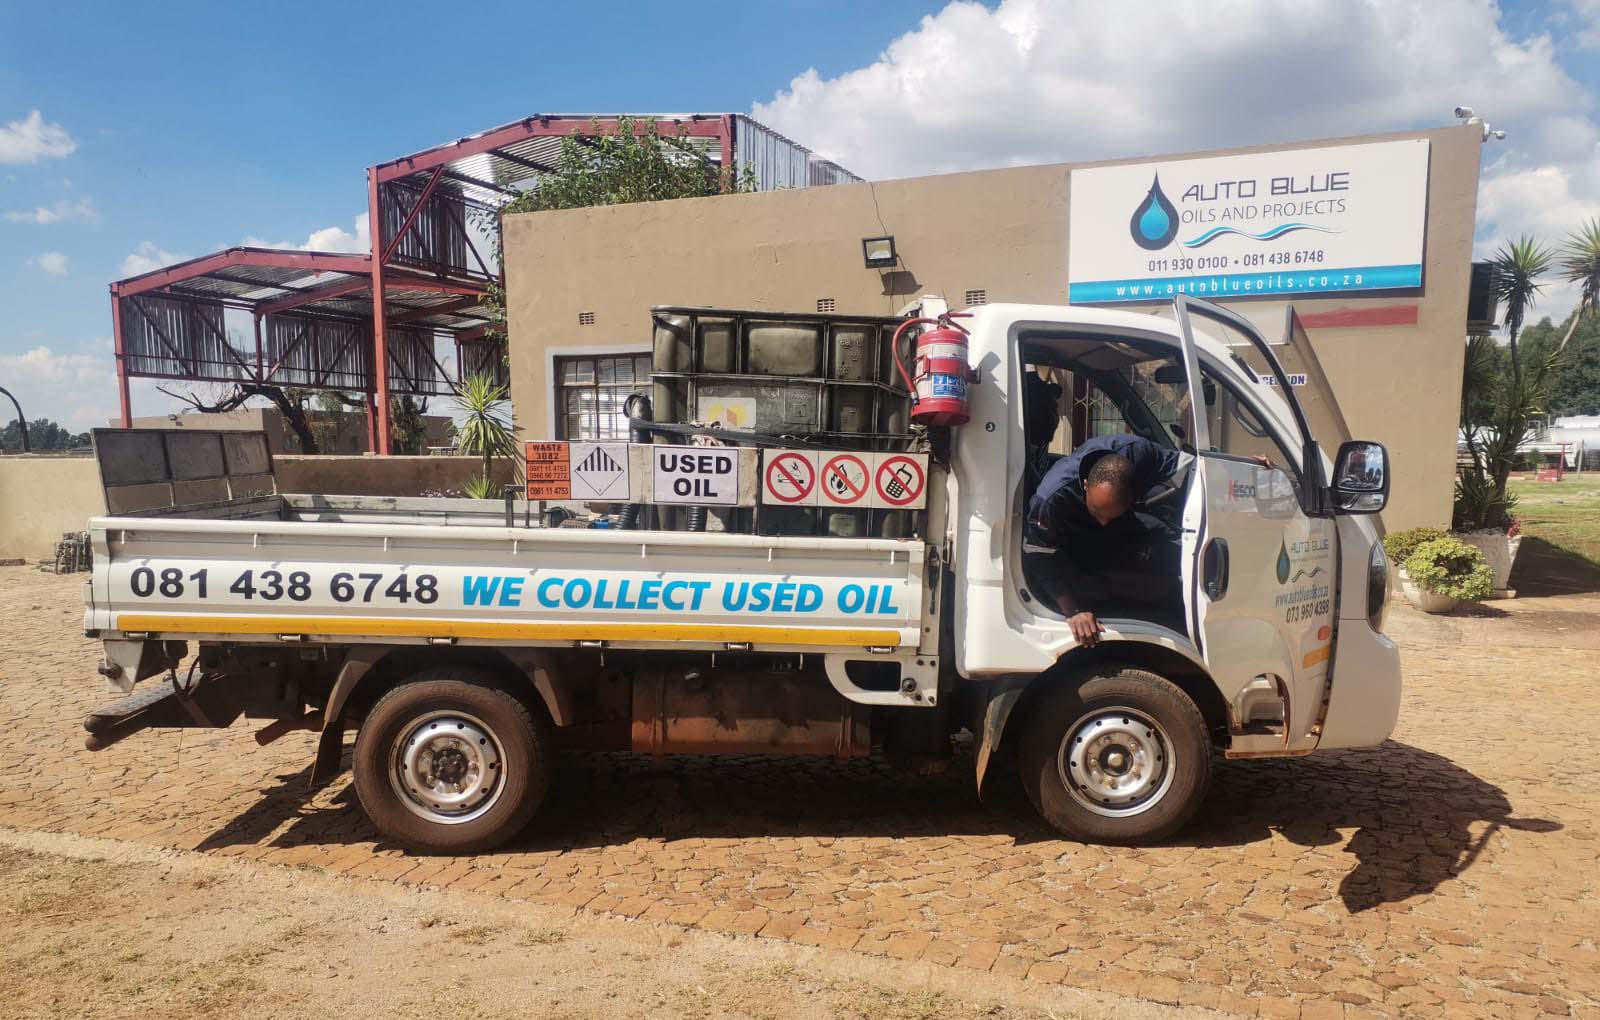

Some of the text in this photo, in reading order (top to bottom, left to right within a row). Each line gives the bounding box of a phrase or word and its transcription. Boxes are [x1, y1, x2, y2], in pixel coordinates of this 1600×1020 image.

[1182, 172, 1350, 203] AUTO BLUE
[1181, 198, 1347, 224] OILS AND PROJECTS
[1148, 250, 1324, 272] 011 930 0100 081 438 6748
[1115, 274, 1364, 297] www.autoblueoils.co.za
[660, 454, 732, 474] USED
[673, 478, 718, 497] OIL
[130, 567, 439, 604] 081 438 6748
[462, 575, 899, 614] WE COLLECT USED OIL
